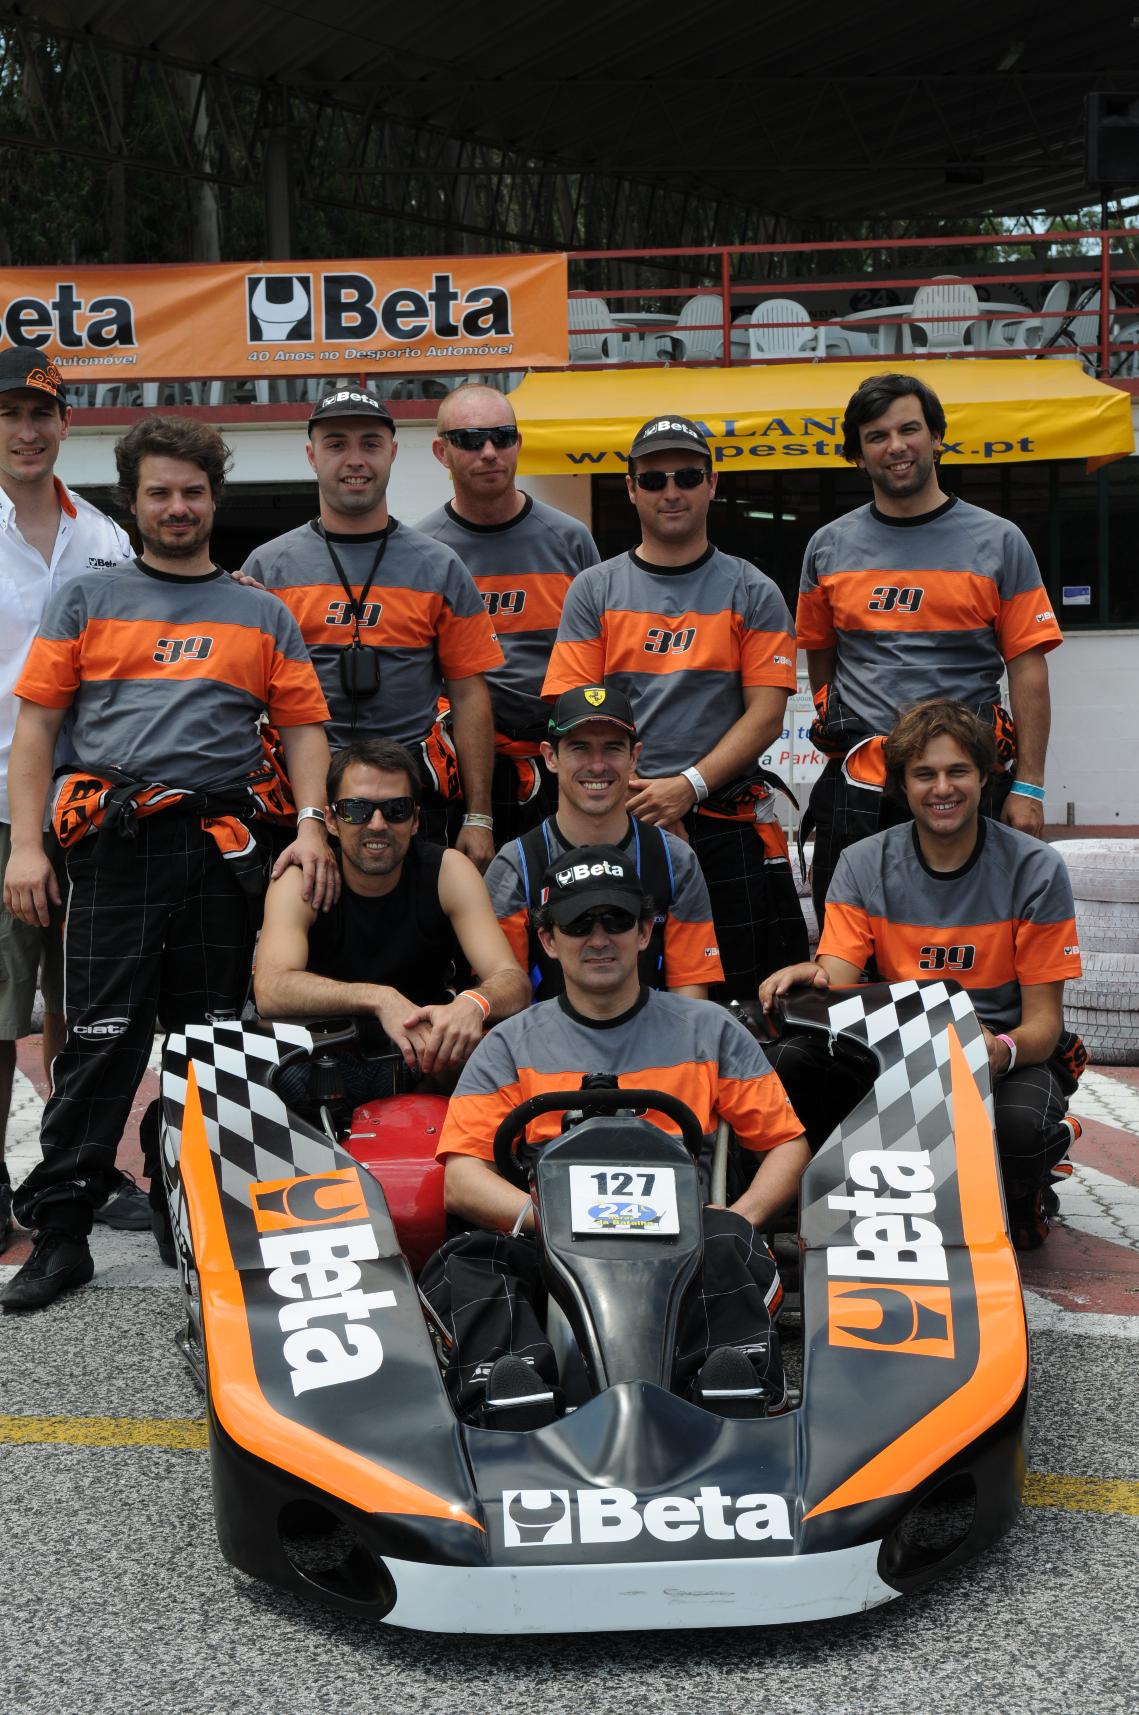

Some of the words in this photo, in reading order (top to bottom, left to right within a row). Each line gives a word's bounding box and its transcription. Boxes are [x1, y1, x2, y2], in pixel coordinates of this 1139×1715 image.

[0, 282, 138, 350] eta
[321, 272, 514, 342] Beta
[52, 353, 137, 367] Automóvel
[248, 351, 270, 362] 40
[274, 350, 315, 362] Anos
[319, 350, 339, 361] no
[344, 348, 421, 361] Desporto
[426, 344, 513, 358] Automóvel
[337, 391, 379, 408] Beta
[657, 420, 698, 439] Beta
[868, 586, 925, 613] 39
[325, 600, 383, 628] 39
[153, 636, 214, 665] 39
[643, 627, 697, 655] 39
[573, 860, 624, 881] Beta
[919, 944, 976, 971] 39
[590, 1172, 656, 1197] 127
[598, 1203, 642, 1219] 24
[826, 1149, 950, 1281] Beta
[259, 1224, 398, 1397] Beta
[577, 1486, 794, 1544] Beta
